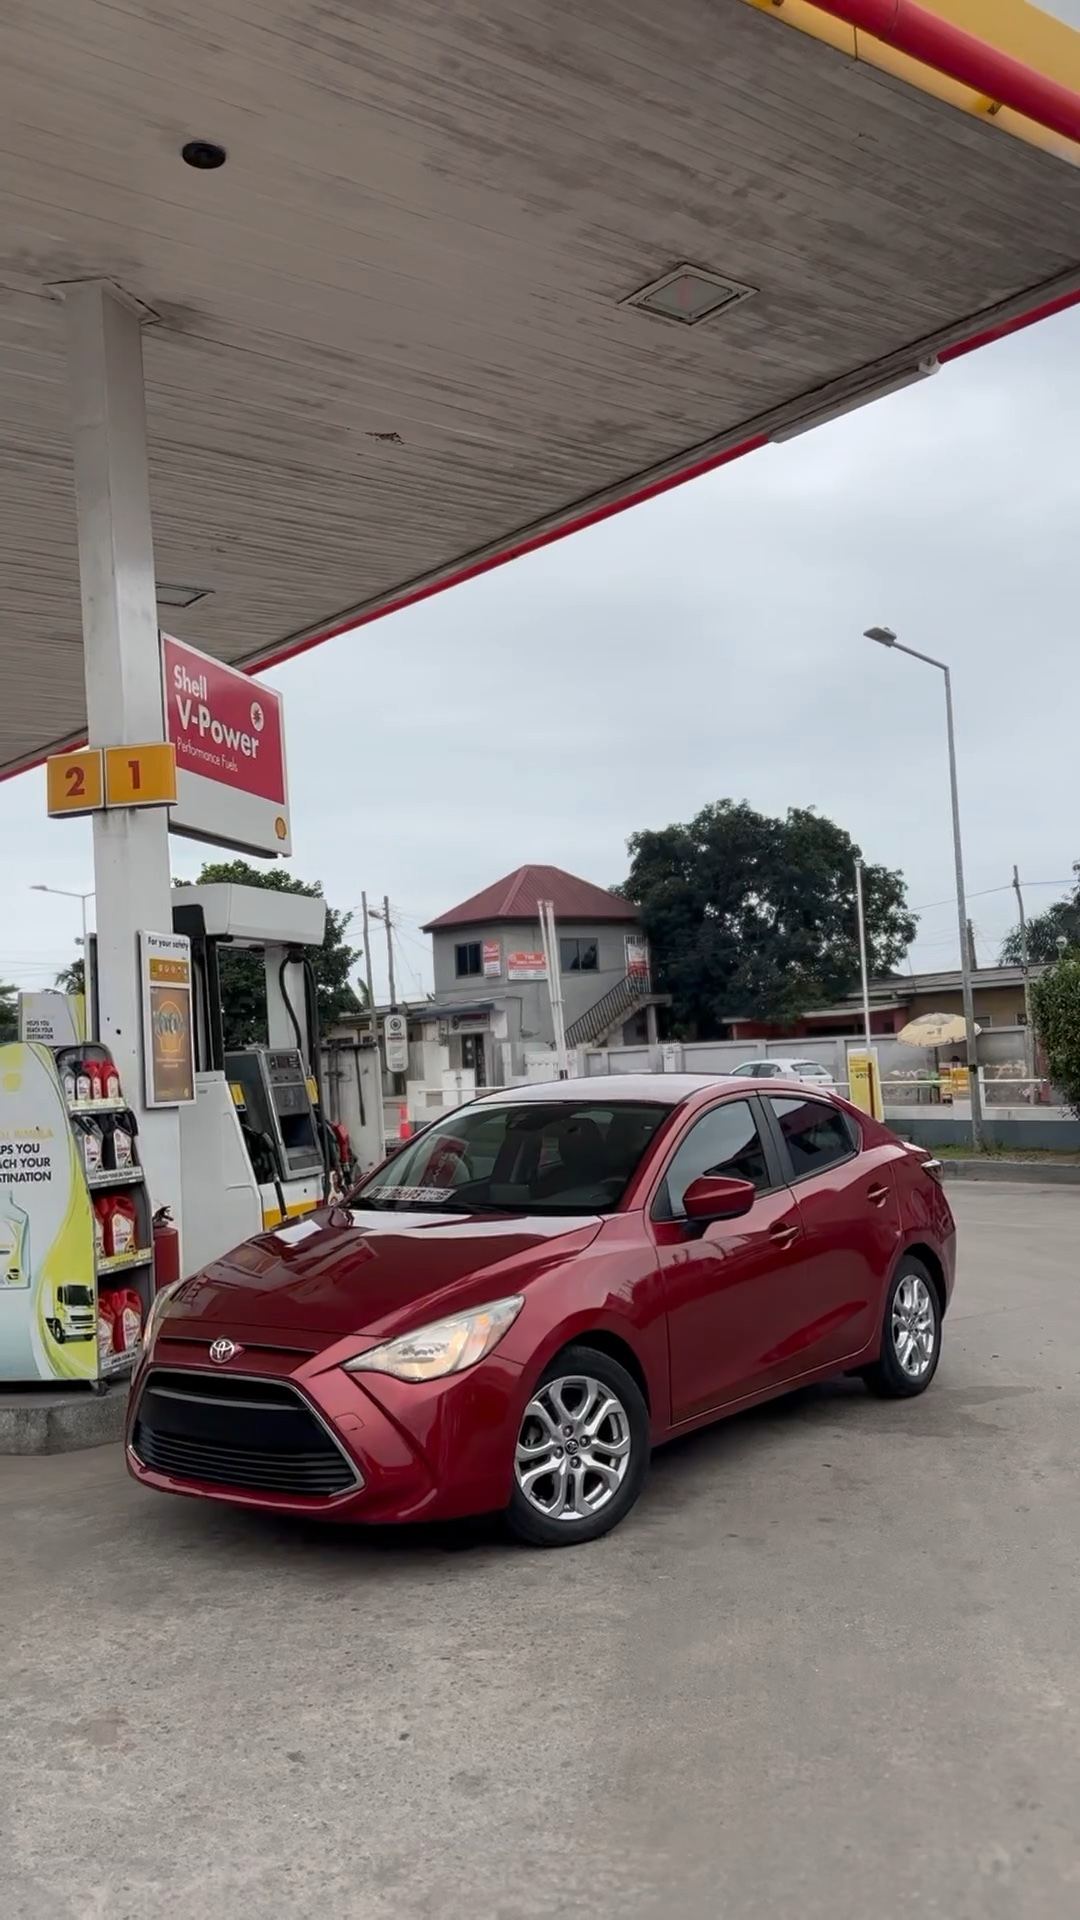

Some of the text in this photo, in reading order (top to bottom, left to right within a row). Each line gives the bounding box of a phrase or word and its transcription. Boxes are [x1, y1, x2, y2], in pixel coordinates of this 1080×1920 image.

[173, 664, 207, 701] Shell
[175, 694, 259, 759] V-Power
[177, 736, 238, 773] Performance Fuels
[65, 766, 85, 797] 2
[128, 760, 141, 790] 1
[148, 936, 189, 951] For your safety
[16, 1143, 40, 1154] YOU
[20, 1157, 51, 1168] YOUR
